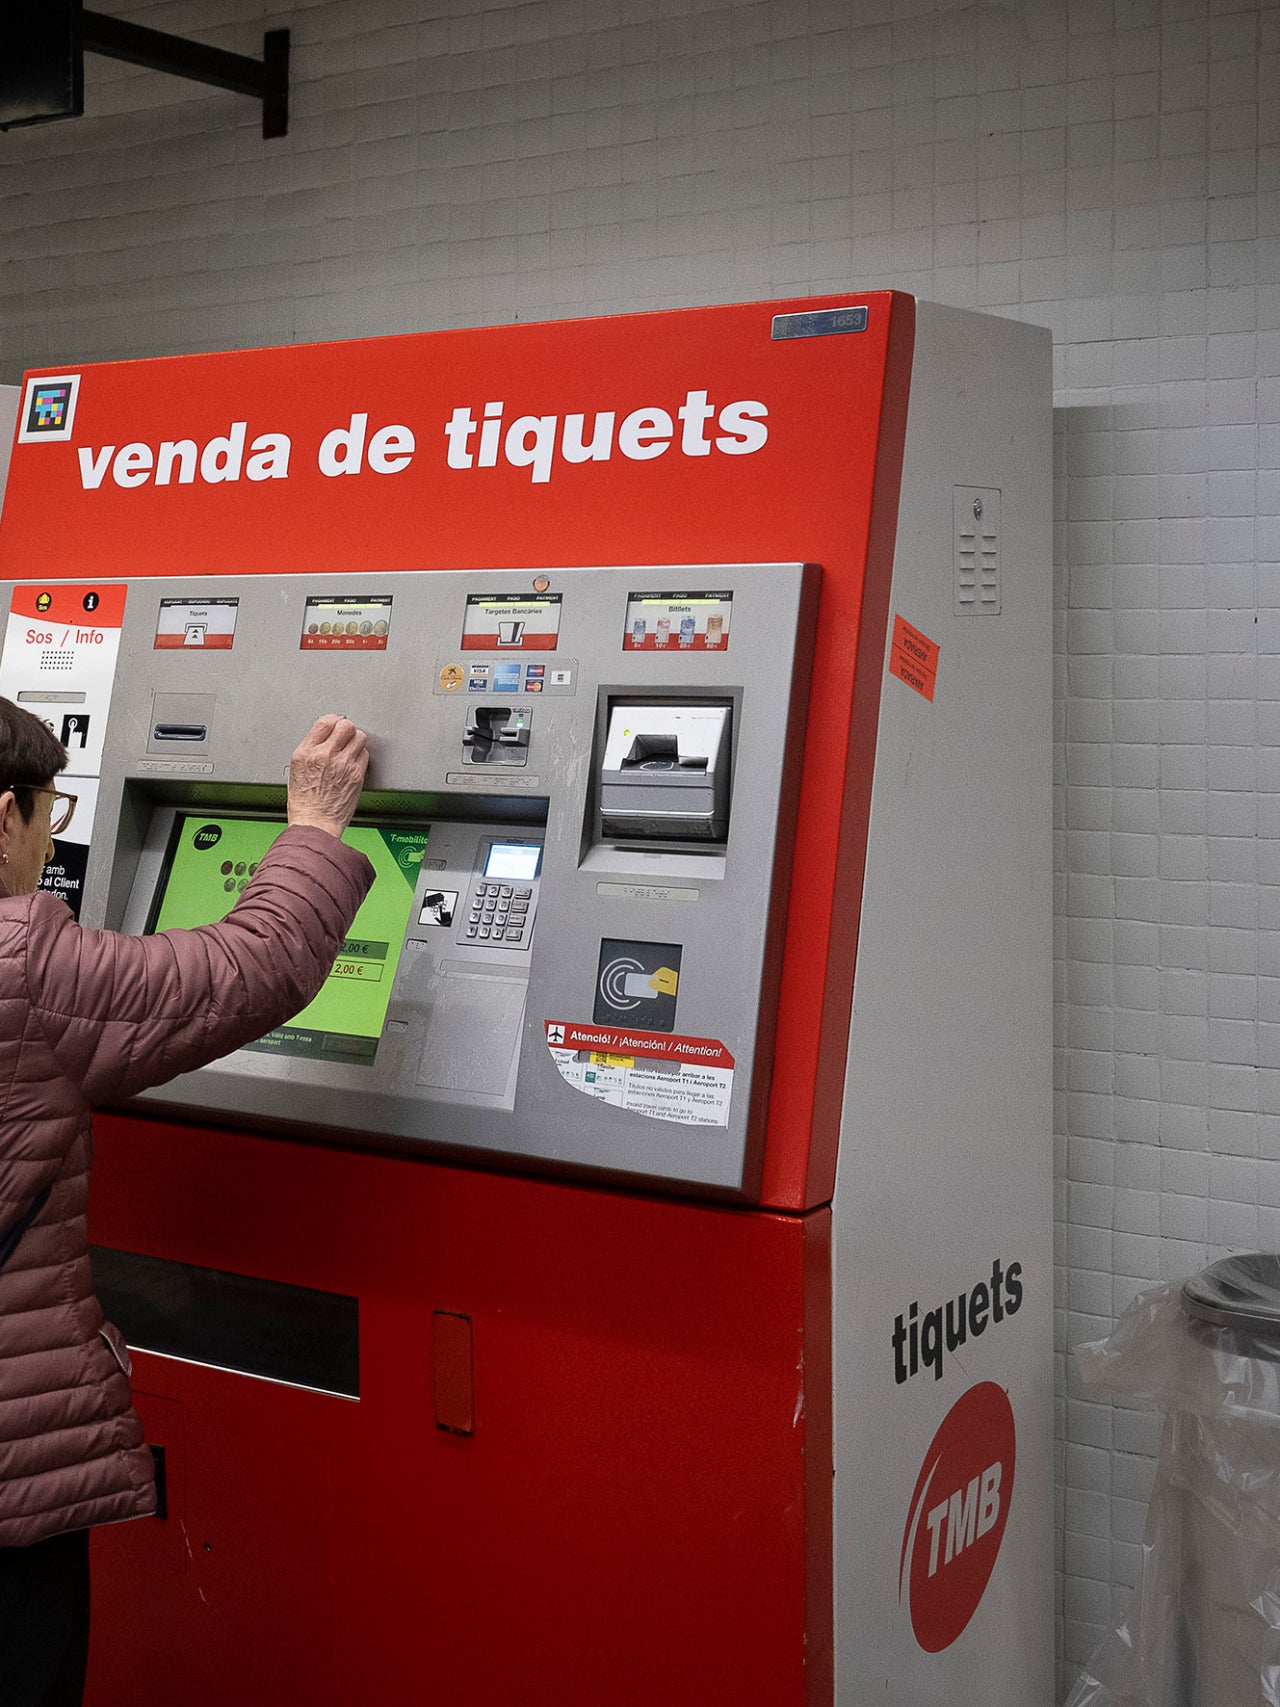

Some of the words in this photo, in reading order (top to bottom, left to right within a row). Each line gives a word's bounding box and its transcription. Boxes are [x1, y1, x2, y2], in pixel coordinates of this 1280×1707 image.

[77, 420, 292, 491] venda
[319, 411, 416, 477] de
[444, 389, 770, 484] tiquets
[25, 629, 53, 644] Sos
[75, 629, 104, 644] Info
[199, 833, 219, 842] TMB
[46, 865, 66, 876] amb
[43, 876, 53, 887] al
[53, 877, 80, 889] Client
[362, 944, 370, 954] €
[334, 963, 355, 975] 2,00
[357, 965, 364, 976] €
[570, 1030, 611, 1044] Atenció!
[619, 1038, 666, 1051] ¡Atención!
[674, 1043, 723, 1057] Attention!
[629, 1072, 656, 1081] estacions
[657, 1075, 681, 1084] Aeroport
[692, 1079, 718, 1088] Aeroport
[655, 1093, 679, 1101] Aeroport
[691, 1097, 715, 1106] Aeroport
[667, 1112, 690, 1121] Aeroport
[892, 1257, 1023, 1385] tiquets
[927, 1461, 1003, 1578] TMB
